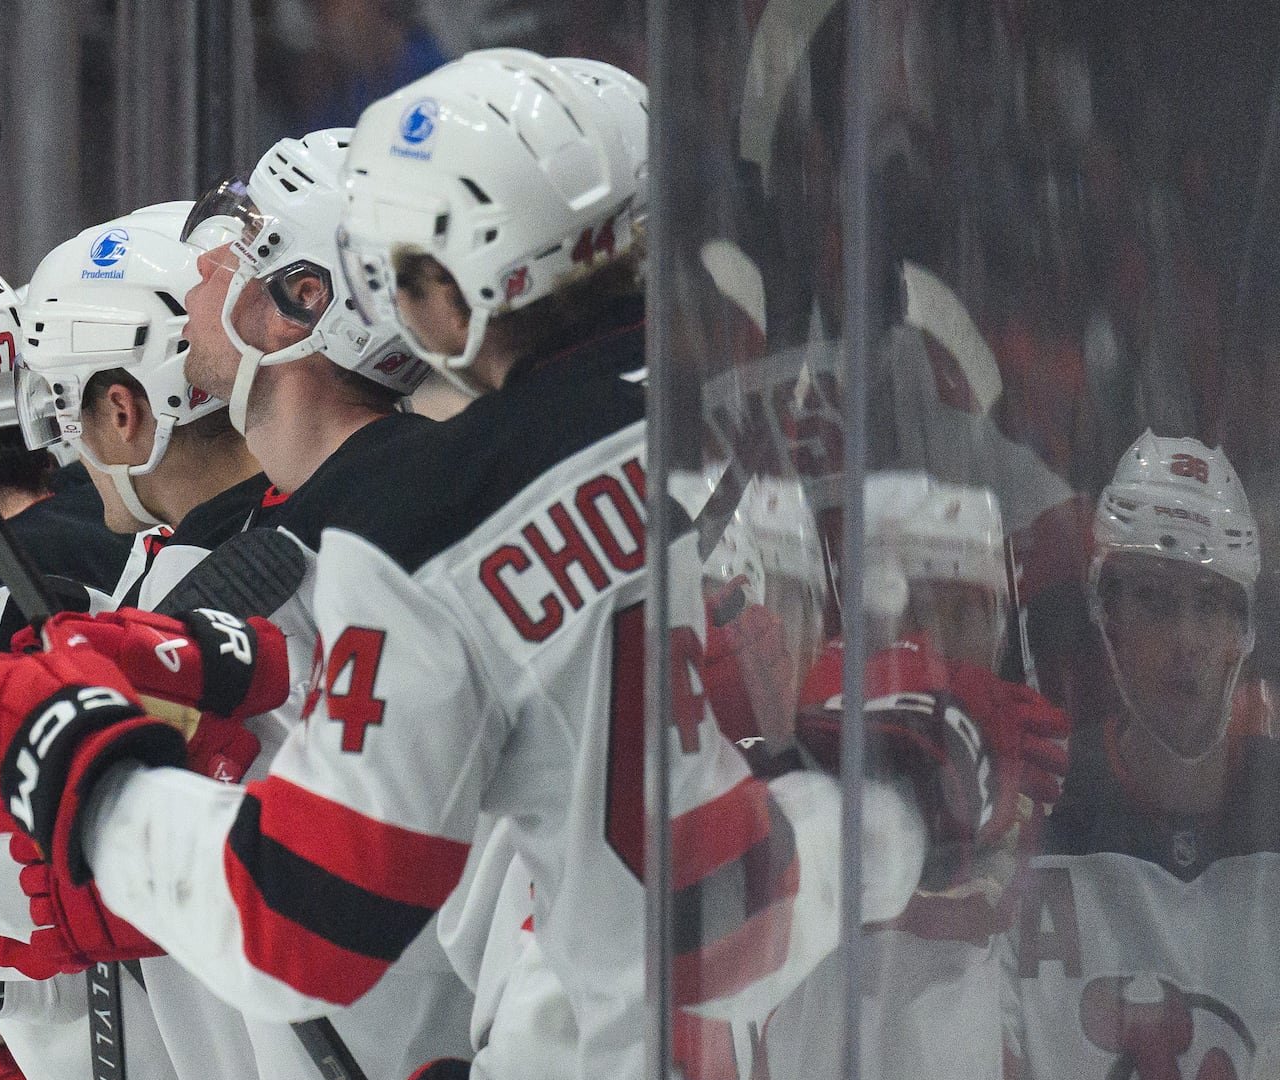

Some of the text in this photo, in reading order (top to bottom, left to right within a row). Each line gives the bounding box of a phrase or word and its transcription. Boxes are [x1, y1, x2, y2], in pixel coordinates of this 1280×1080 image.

[81, 269, 125, 280] Prudential
[478, 458, 646, 643] CHO
[9, 686, 130, 833] CCM
